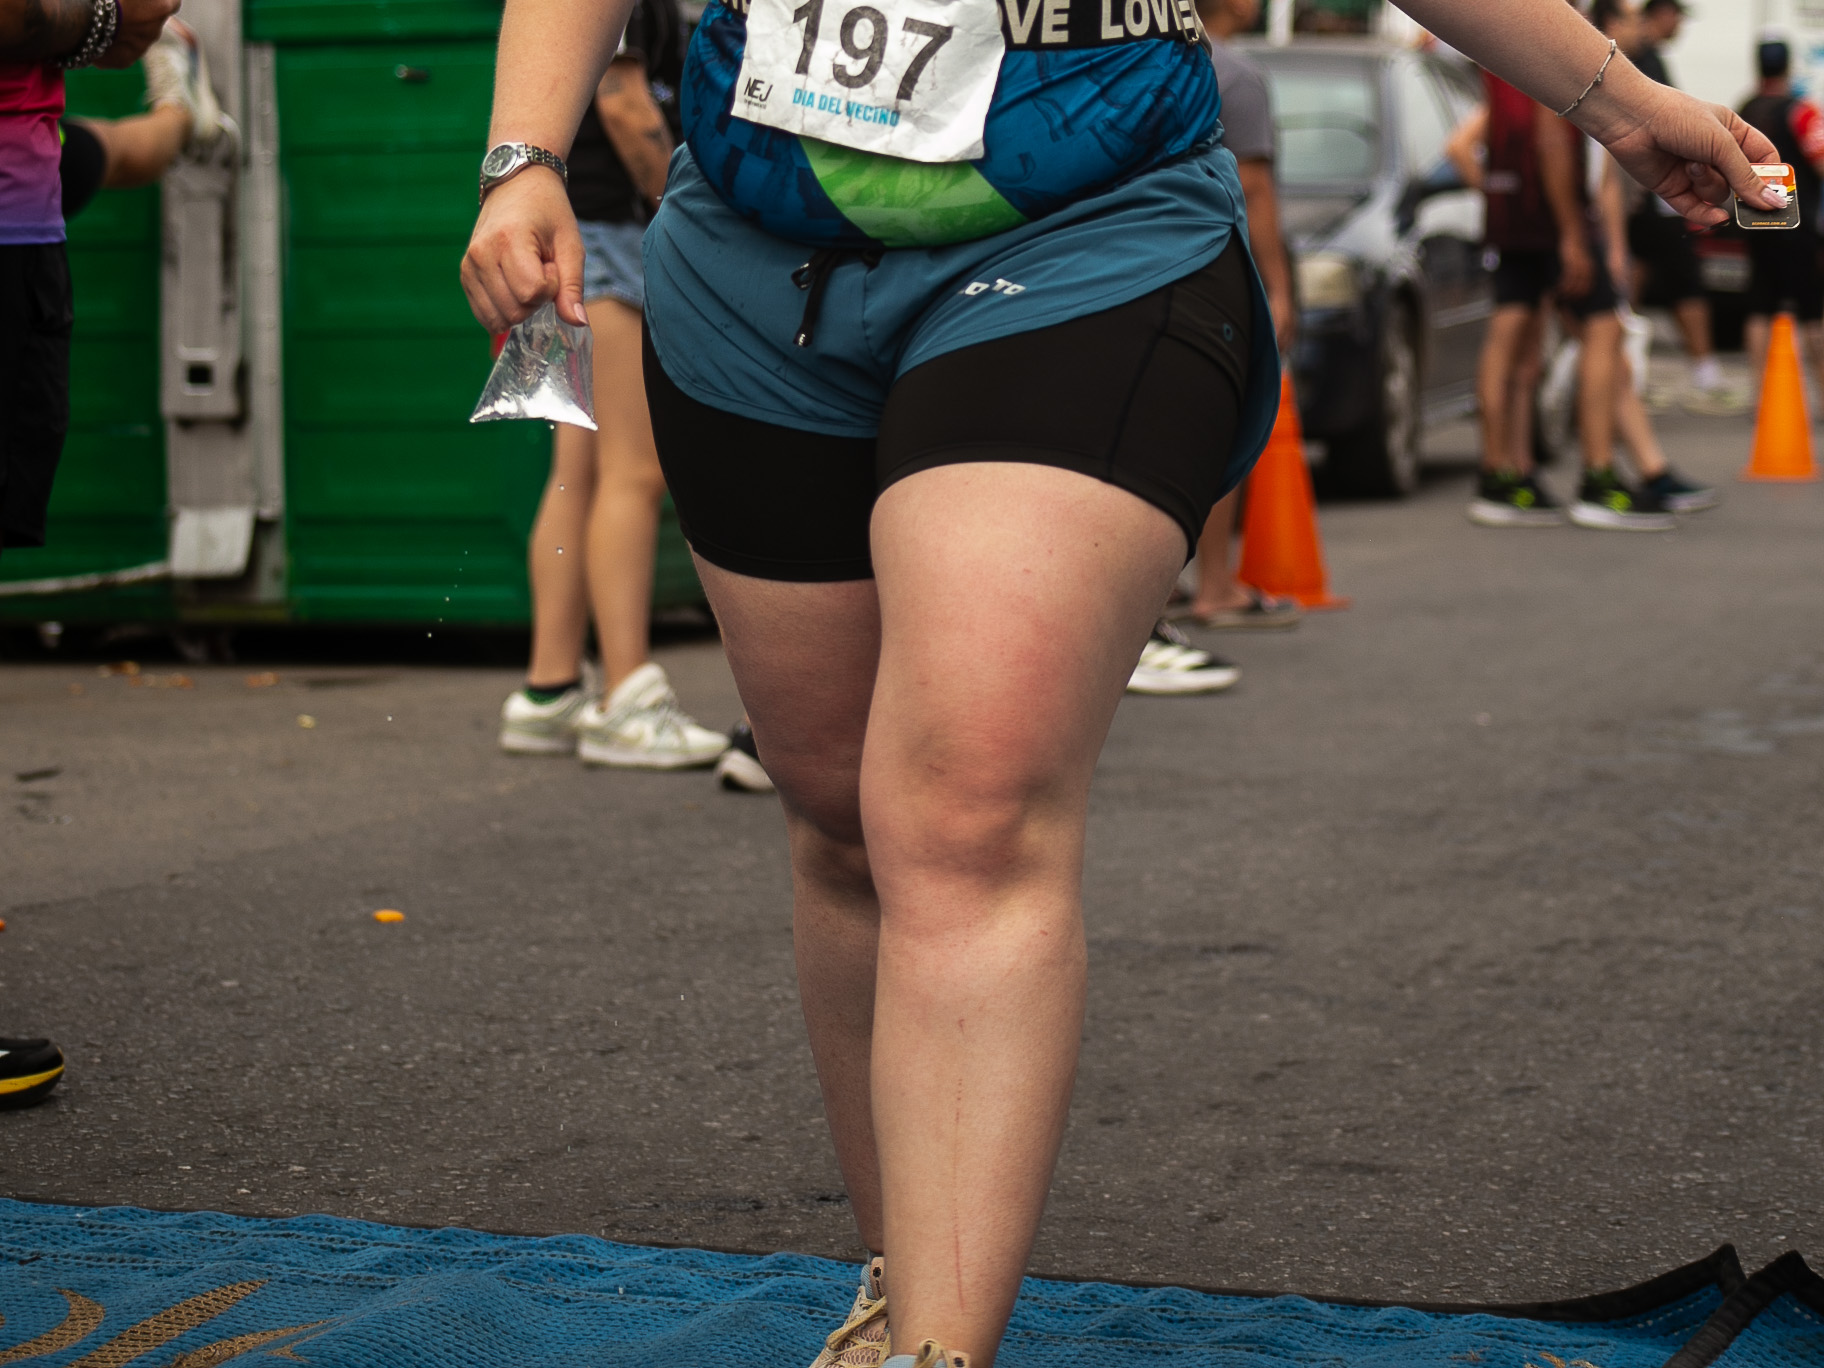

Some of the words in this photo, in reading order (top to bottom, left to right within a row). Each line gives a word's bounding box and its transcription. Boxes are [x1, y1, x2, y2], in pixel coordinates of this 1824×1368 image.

[792, 88, 815, 109] DIA
[818, 94, 842, 115] DEL
[846, 101, 900, 127] VECINO
